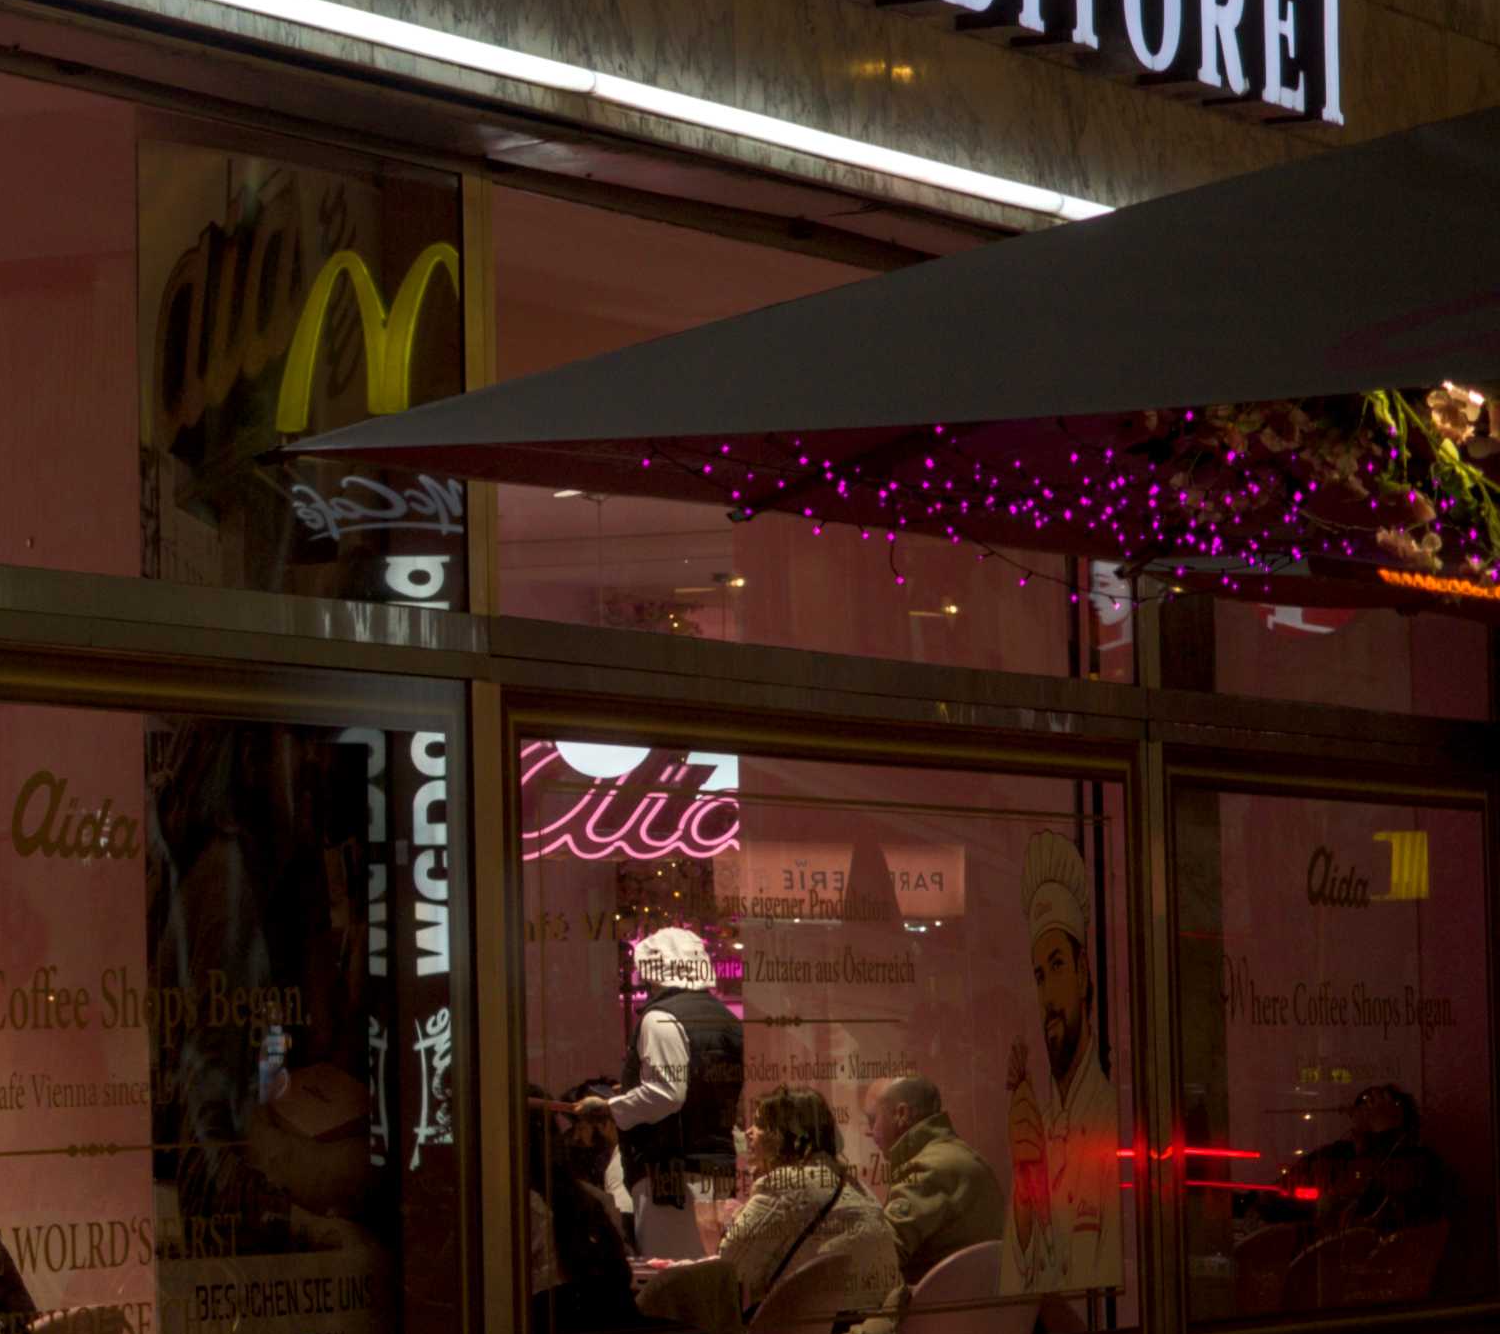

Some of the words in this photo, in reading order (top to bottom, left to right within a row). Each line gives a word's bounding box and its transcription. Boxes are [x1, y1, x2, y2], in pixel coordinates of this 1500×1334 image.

[755, 950, 813, 983] Zutaten
[816, 960, 841, 983] aus
[843, 945, 916, 985] Österreich
[101, 965, 198, 1049] Shops
[1219, 953, 1289, 1027] Where
[1293, 980, 1348, 1027] Coffee
[1351, 980, 1401, 1041] Shops
[847, 1051, 920, 1080] Marmeladen
[30, 1072, 99, 1109] Vienna
[102, 1071, 149, 1108] since
[302, 1276, 335, 1316] SIE
